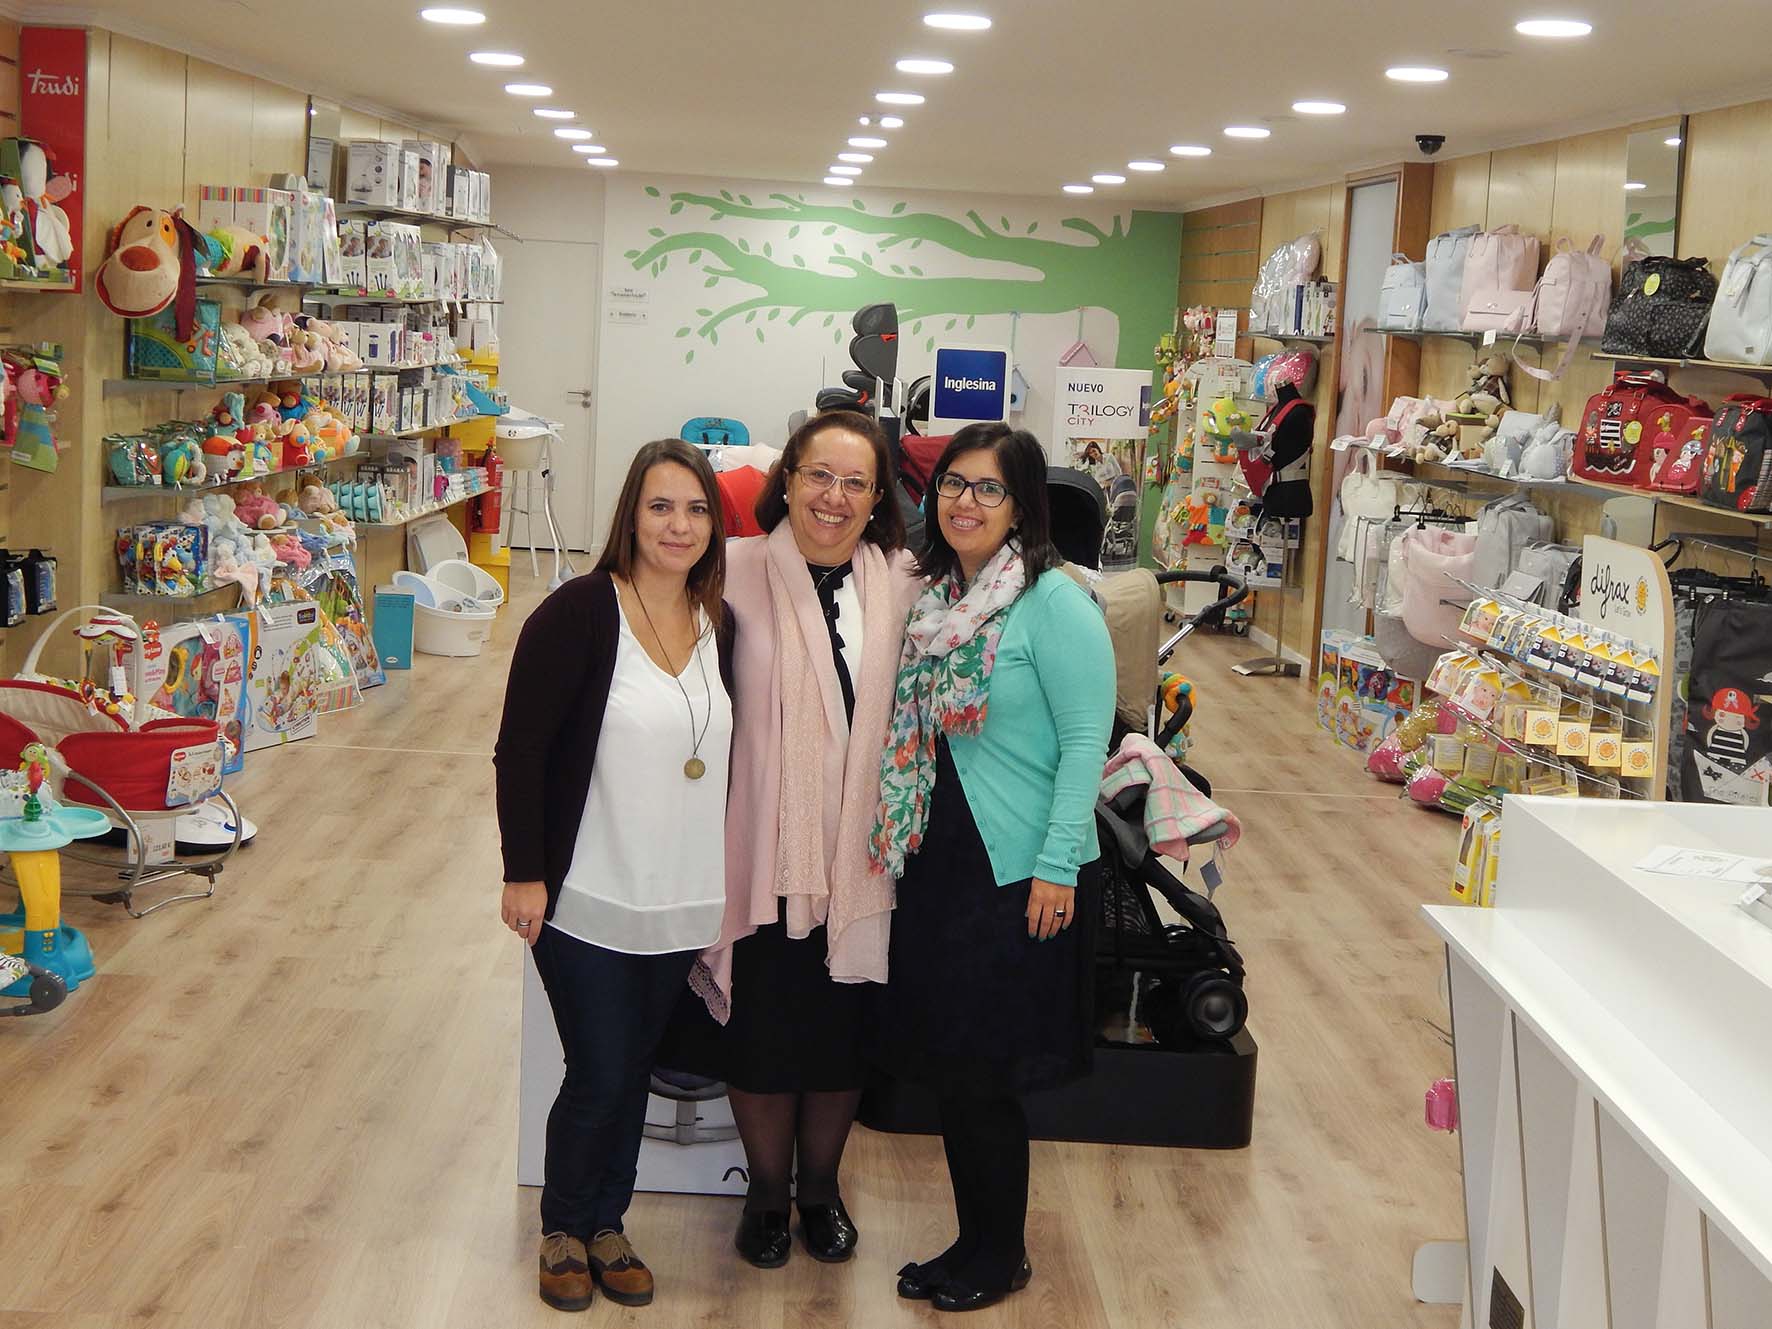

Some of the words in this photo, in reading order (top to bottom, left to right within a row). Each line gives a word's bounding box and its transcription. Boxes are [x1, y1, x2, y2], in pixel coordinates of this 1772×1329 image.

[27, 68, 80, 96] Trudi
[944, 376, 996, 392] Inglesina
[1067, 382, 1104, 393] NUEVO
[1590, 563, 1631, 620] difrax
